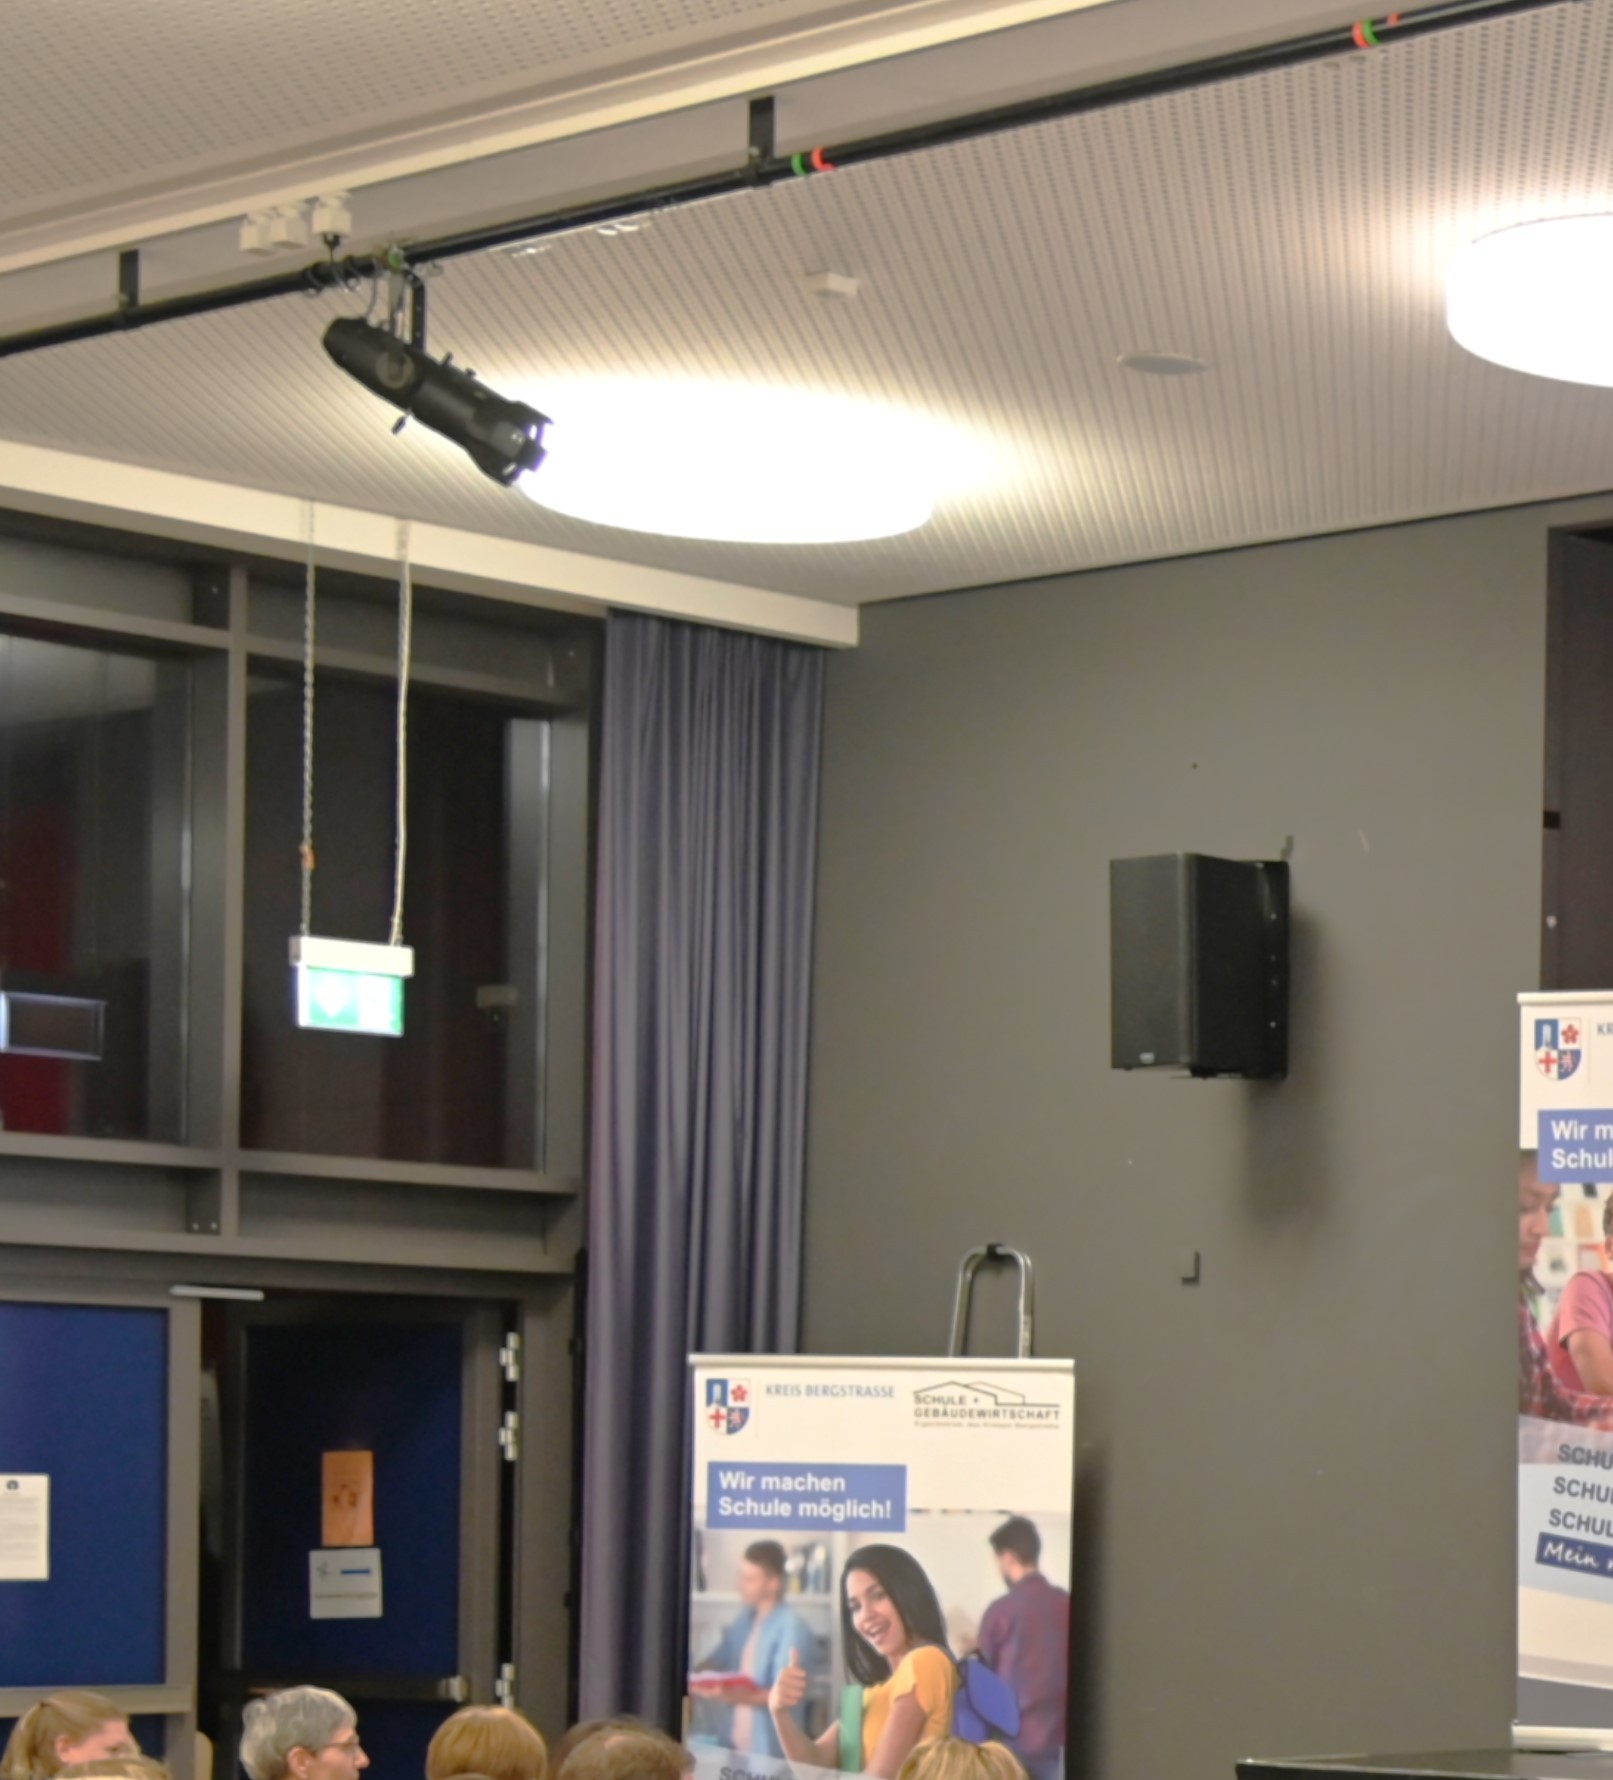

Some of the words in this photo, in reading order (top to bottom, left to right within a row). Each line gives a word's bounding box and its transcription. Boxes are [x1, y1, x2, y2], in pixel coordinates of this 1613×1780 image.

[1551, 1119, 1587, 1140] Wir
[766, 1384, 802, 1397] KREIS
[805, 1384, 895, 1398] BERGSTRASSE
[914, 1394, 967, 1405] SCHULE
[914, 1407, 1060, 1420] GEBÄUDEWIRTSCHAFT
[719, 1470, 755, 1490] Wir
[761, 1472, 845, 1492] machen
[719, 1496, 792, 1517] Schule
[798, 1498, 891, 1523] möglich!
[1543, 1541, 1599, 1568] Mein
